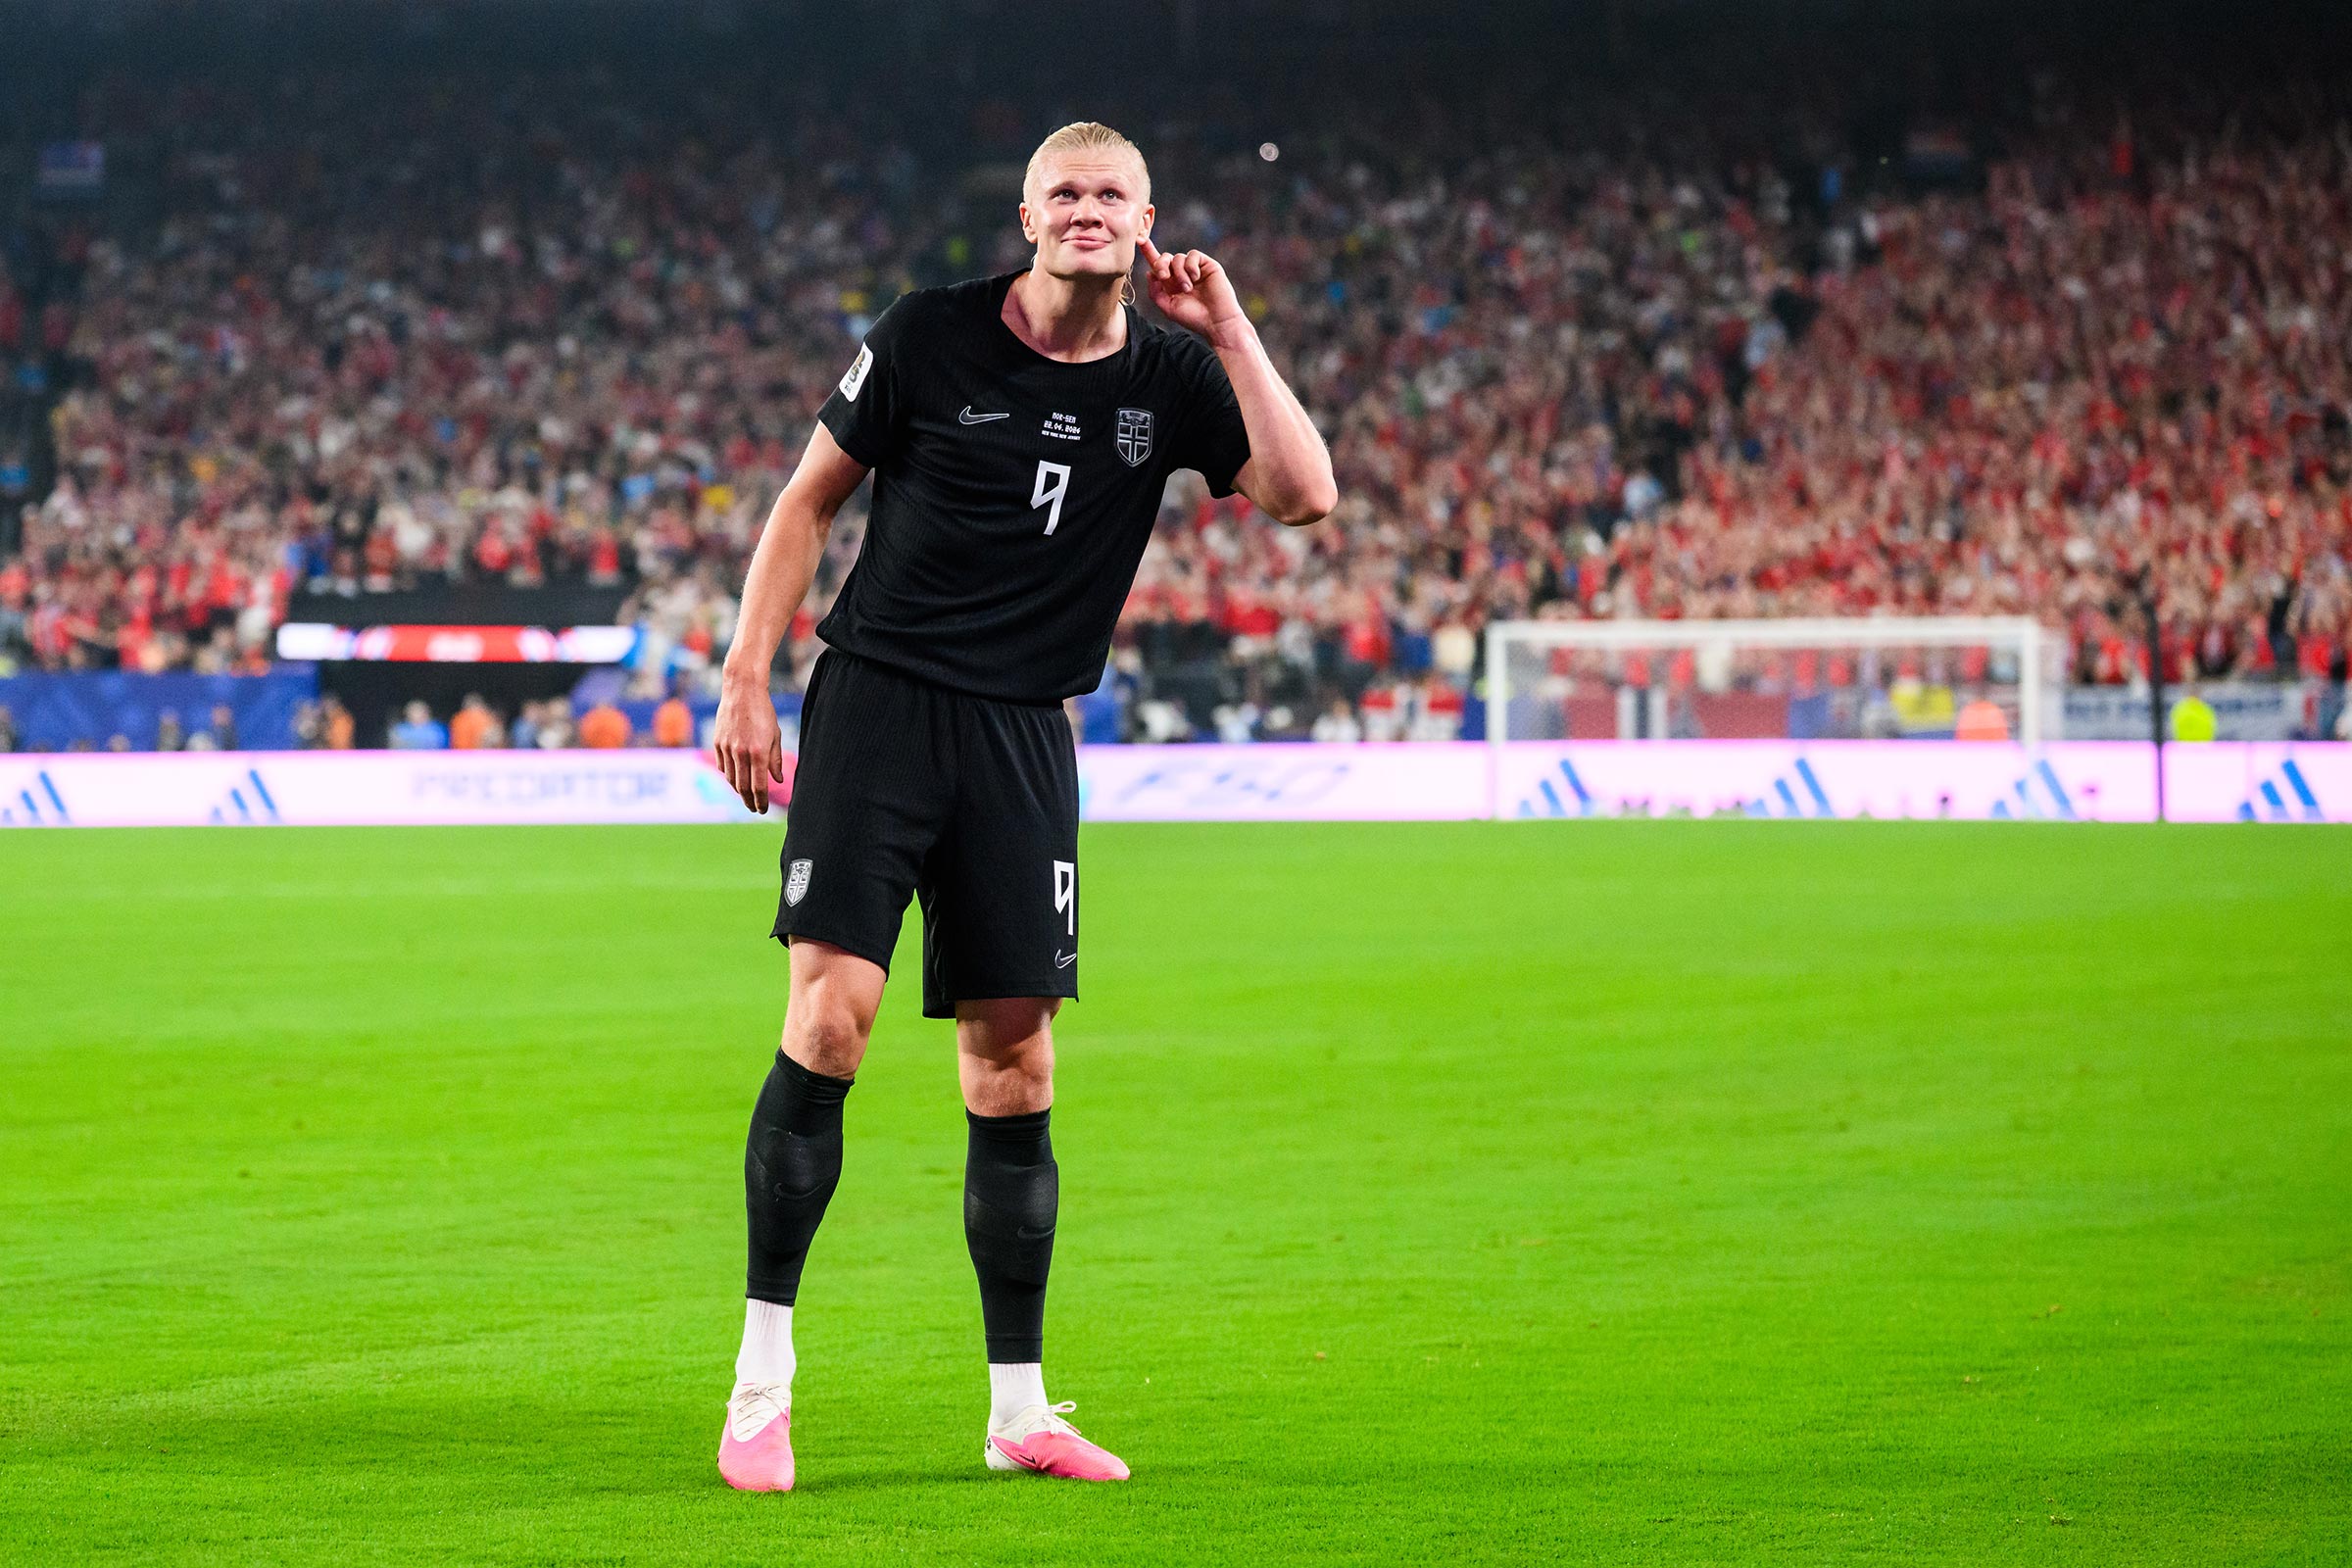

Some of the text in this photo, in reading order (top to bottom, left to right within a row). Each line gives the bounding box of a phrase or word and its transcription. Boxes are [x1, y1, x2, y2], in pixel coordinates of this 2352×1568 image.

[1053, 413, 1076, 423] NOR-SEN
[1030, 460, 1071, 536] 9
[1053, 859, 1075, 936] 9
